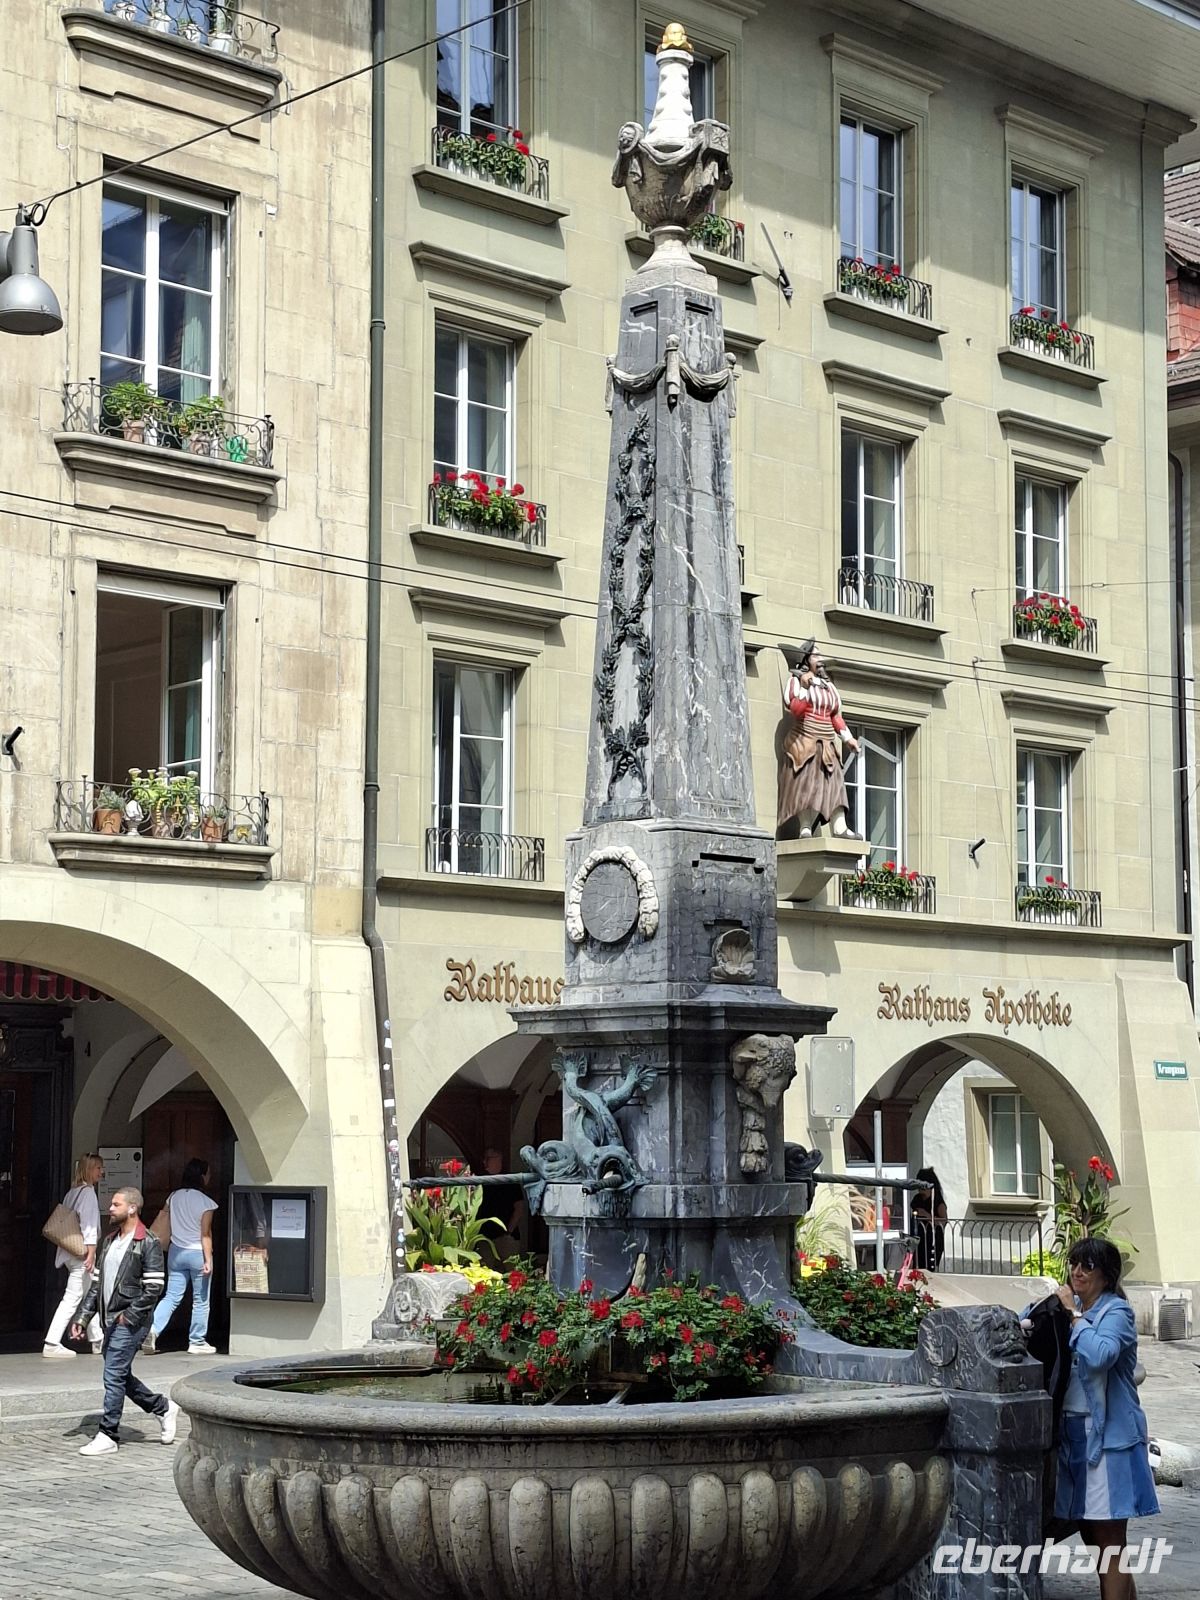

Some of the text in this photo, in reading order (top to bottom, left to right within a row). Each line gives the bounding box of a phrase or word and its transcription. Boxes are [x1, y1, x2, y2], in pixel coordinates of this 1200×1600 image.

[444, 957, 565, 1007] Rathaus
[877, 982, 1073, 1035] Rathaus Apotheke
